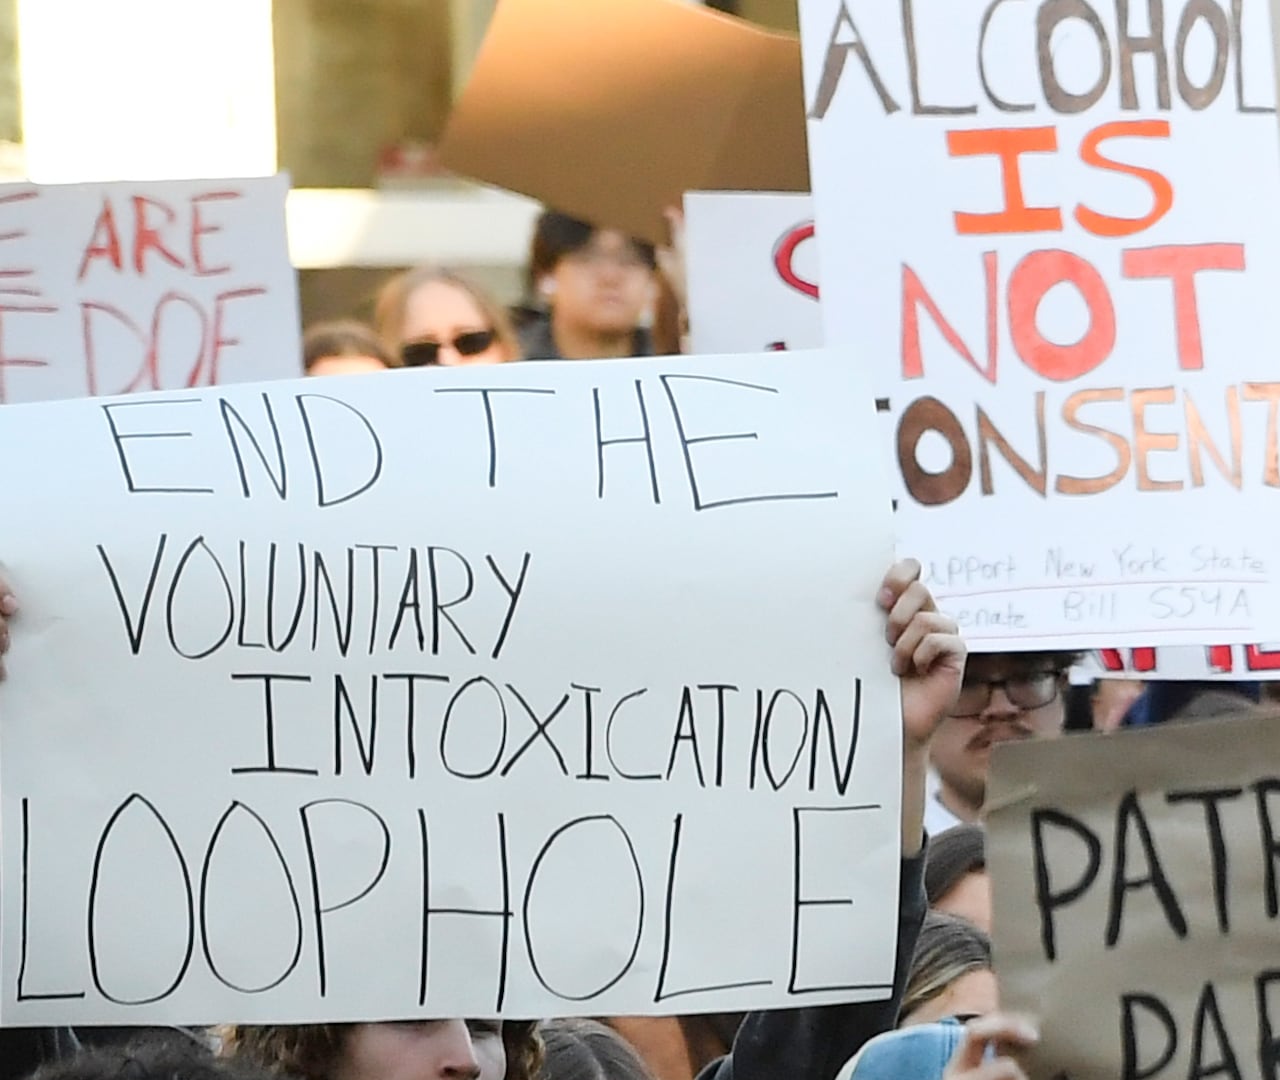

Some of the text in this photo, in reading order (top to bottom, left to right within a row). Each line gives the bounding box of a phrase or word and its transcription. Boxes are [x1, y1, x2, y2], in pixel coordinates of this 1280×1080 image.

[807, 0, 1277, 119] ALCOHOL
[77, 191, 242, 281] ARE
[945, 119, 1174, 237] IS
[901, 243, 1245, 385] NOT
[102, 373, 838, 510] END THE
[98, 534, 531, 659] VOLUNTARY
[926, 543, 1269, 586] upport New York State
[959, 601, 1028, 629] enate
[1063, 591, 1117, 622] Bill
[232, 674, 863, 795] INTOXICATION
[18, 793, 894, 1013] LOOPHOLE
